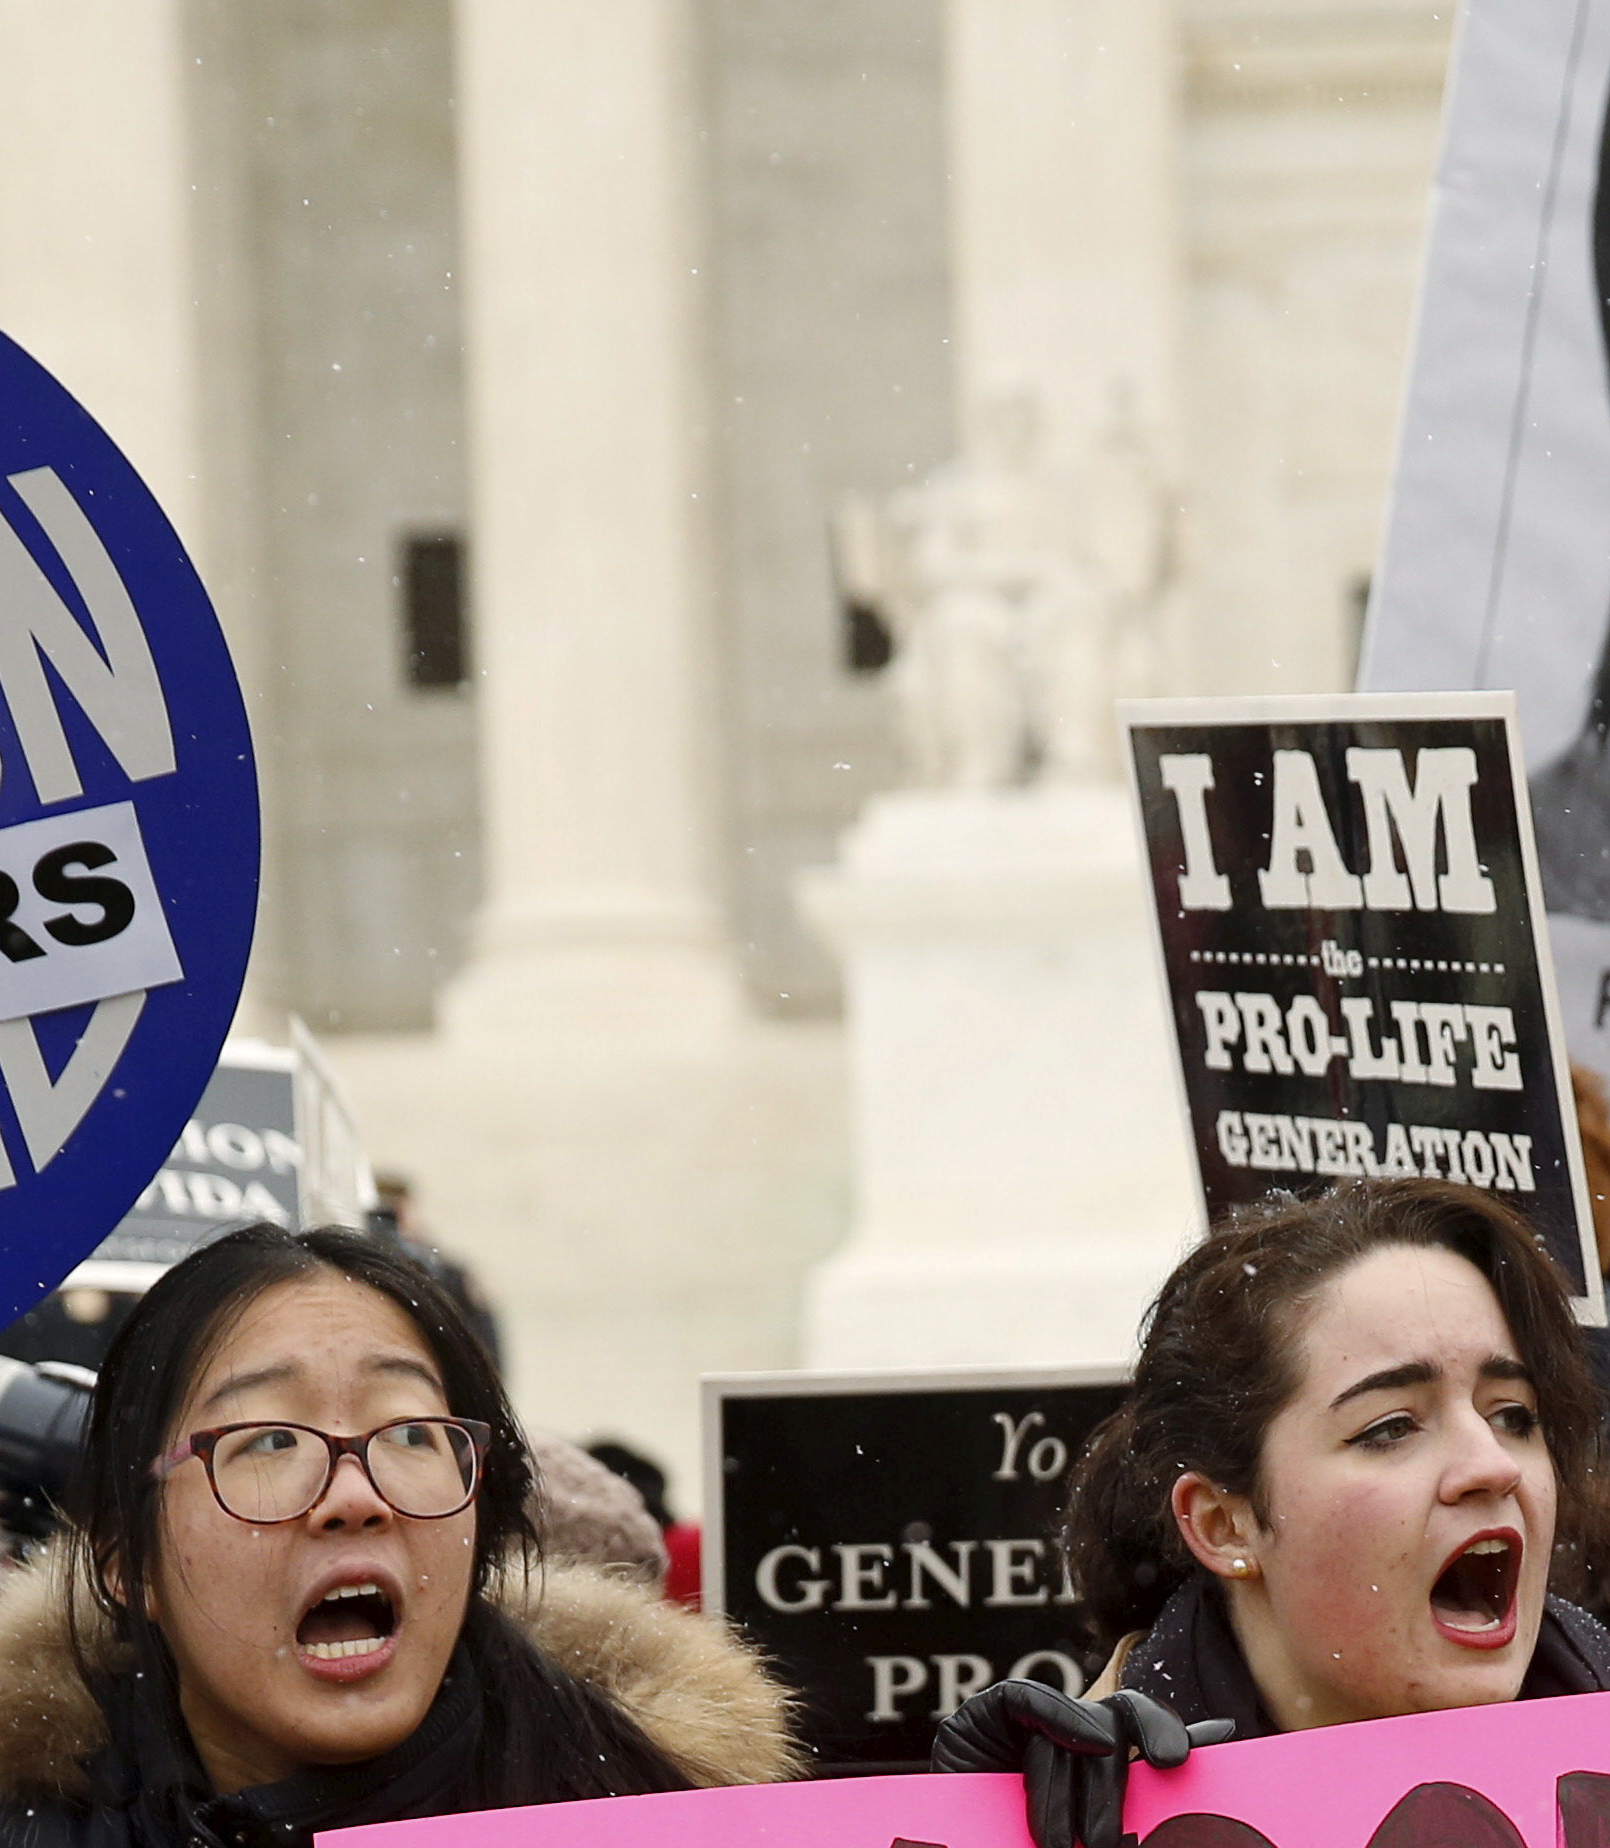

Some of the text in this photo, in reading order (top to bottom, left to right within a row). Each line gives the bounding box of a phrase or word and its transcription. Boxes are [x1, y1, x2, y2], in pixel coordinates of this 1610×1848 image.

[1159, 747, 1497, 914] I AM
[1321, 939, 1363, 978] the
[1195, 990, 1523, 1091] PRO-LIFE
[1216, 1110, 1536, 1192] GENERATION
